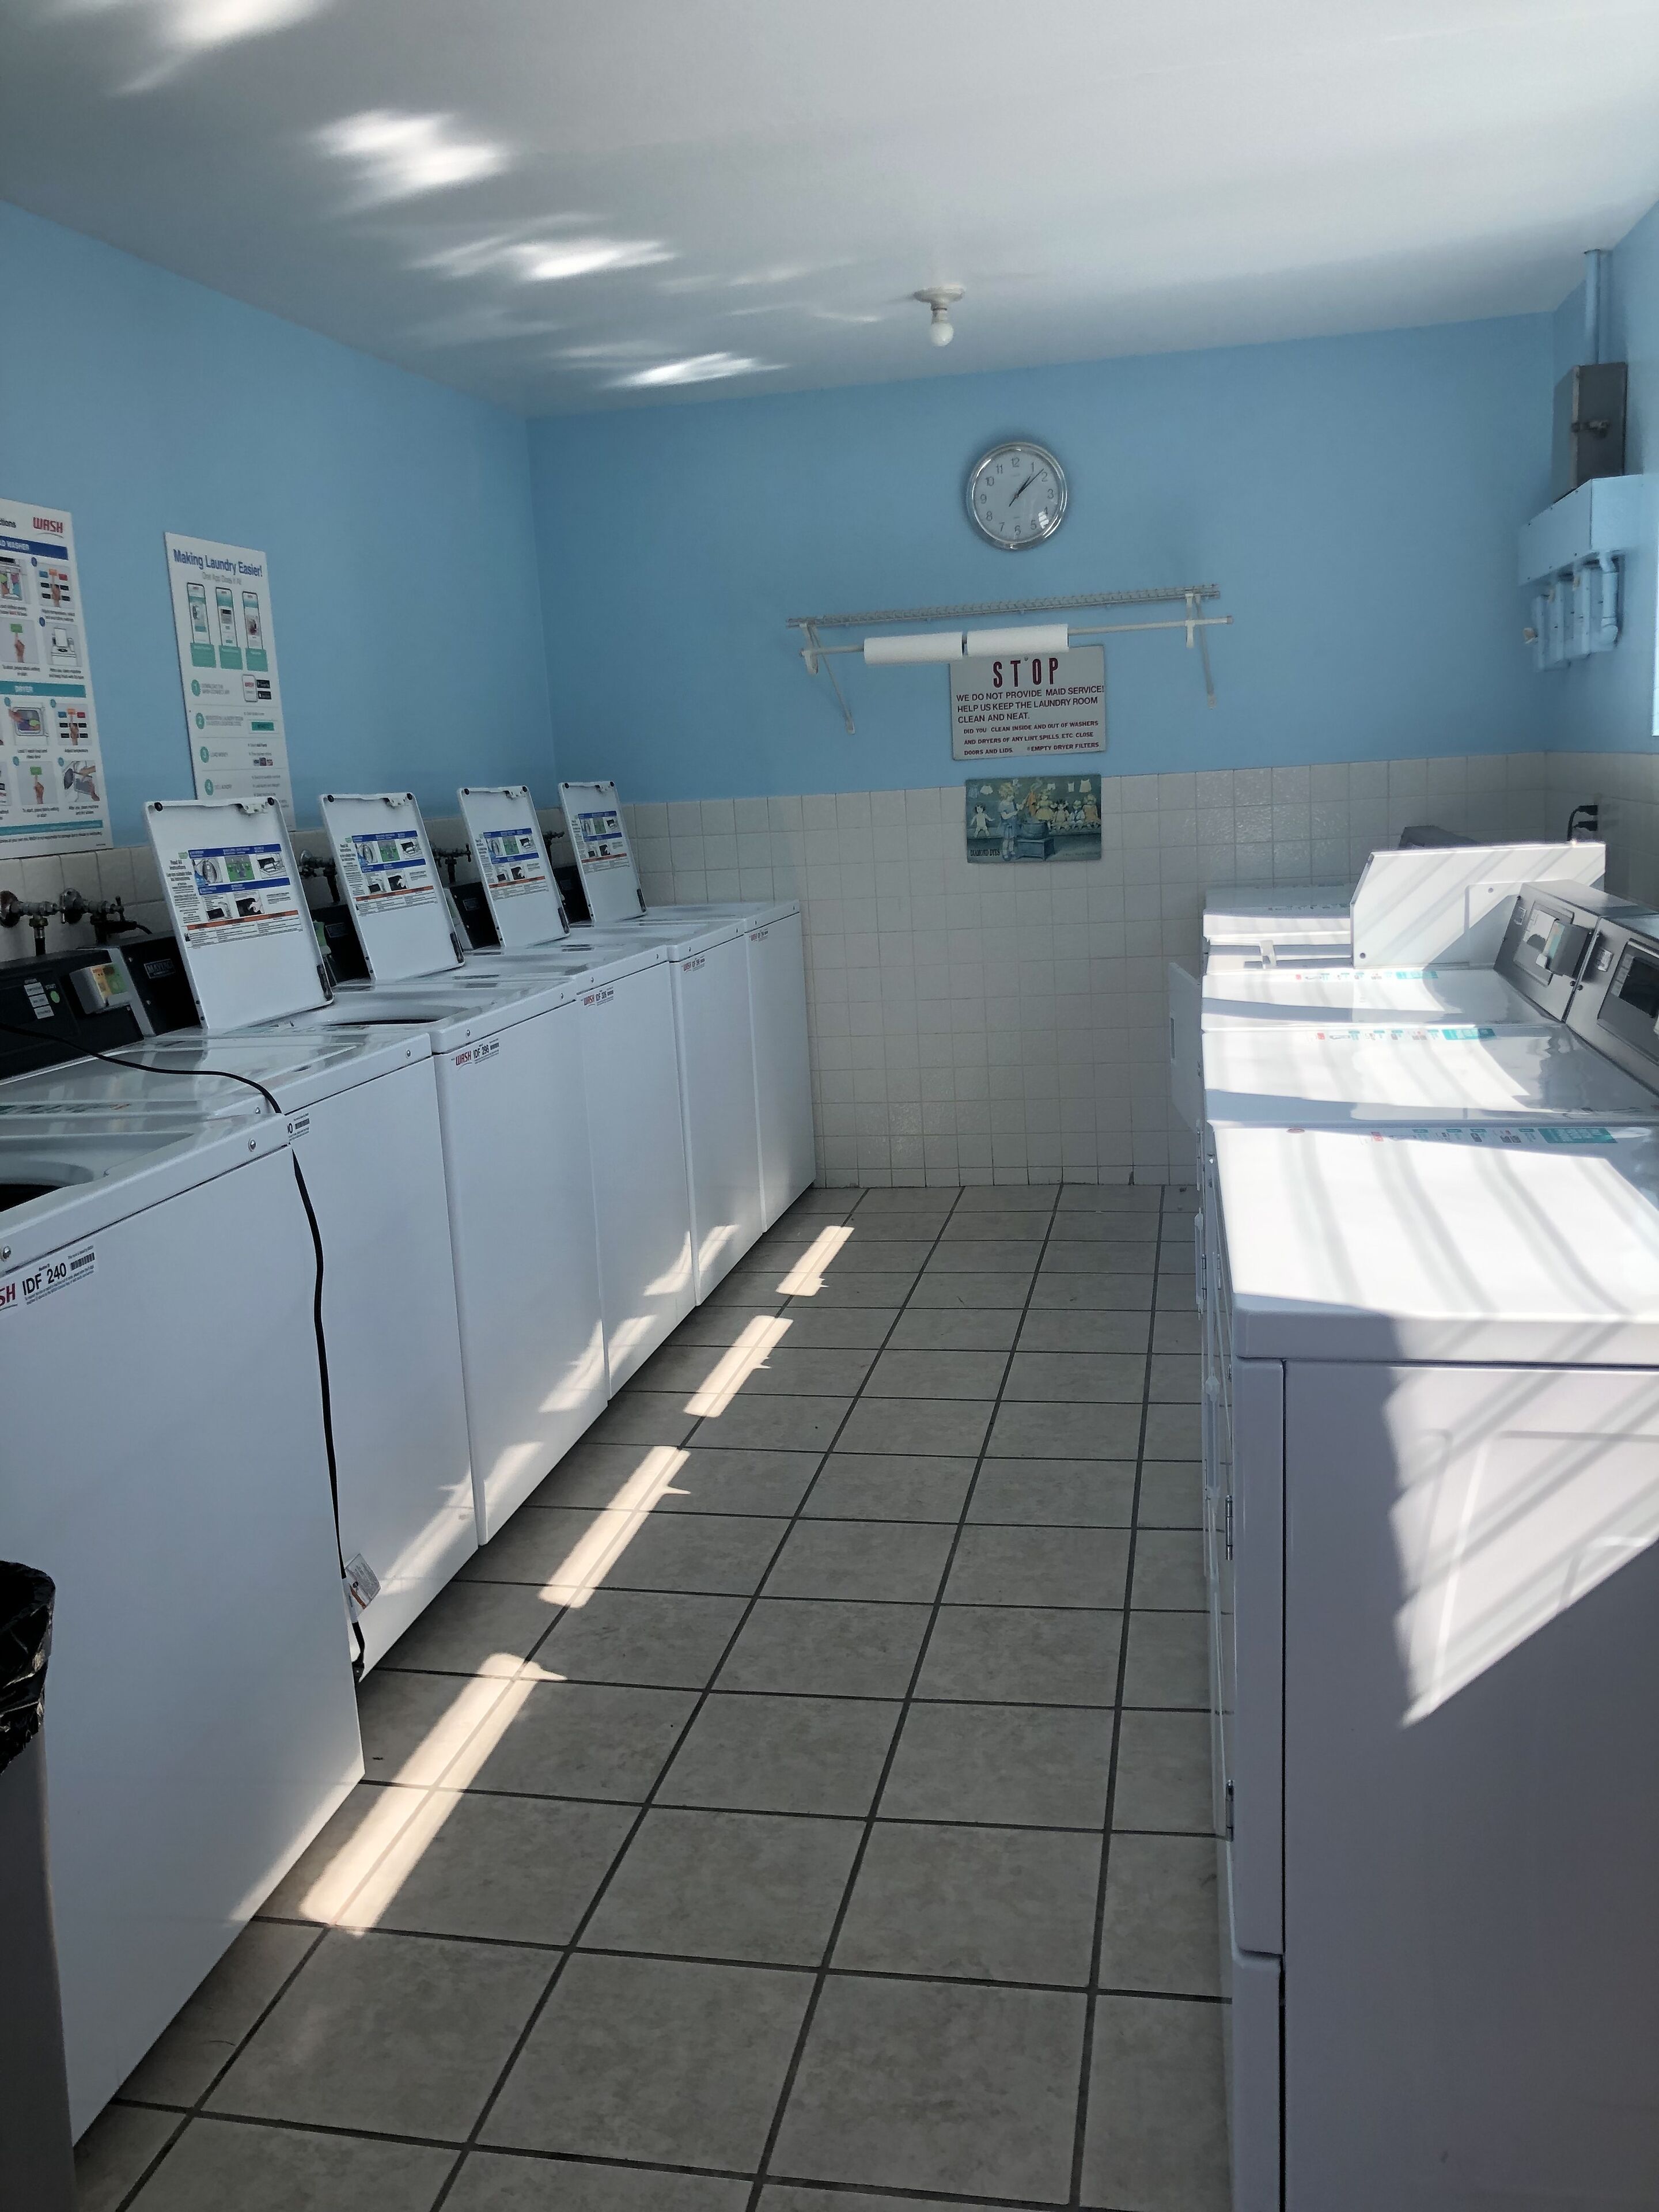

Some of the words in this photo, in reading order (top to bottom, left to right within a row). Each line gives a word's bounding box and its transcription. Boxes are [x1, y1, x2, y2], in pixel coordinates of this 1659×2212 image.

[1012, 457, 1020, 467] 12
[1031, 462, 1035, 472] 1
[997, 464, 1003, 474] 11
[986, 476, 994, 486] 10
[1041, 472, 1048, 482] 2
[980, 494, 987, 504] 9
[1047, 489, 1054, 499] 3
[986, 511, 993, 521] 8
[33, 517, 63, 533] WASH
[999, 522, 1005, 531] 7
[1014, 525, 1021, 535] 6
[1031, 520, 1037, 530] 5
[173, 549, 203, 570] Making
[205, 555, 236, 575] Laundry
[238, 561, 263, 577] Easier!
[993, 658, 1058, 688] STOP
[1006, 690, 1042, 699] PROVIDE
[1046, 688, 1066, 696] MAID
[1068, 685, 1104, 695] SERVICE!
[957, 704, 978, 713] HELP
[1034, 699, 1071, 707] LAUNDRY
[1073, 696, 1098, 705] ROOM
[958, 715, 985, 724] CLEAN
[1006, 712, 1030, 720] NEAT.
[584, 994, 594, 1006] WASH
[456, 1050, 472, 1066] WASH
[22, 1273, 41, 1296] IDF
[47, 1263, 67, 1284] 240
